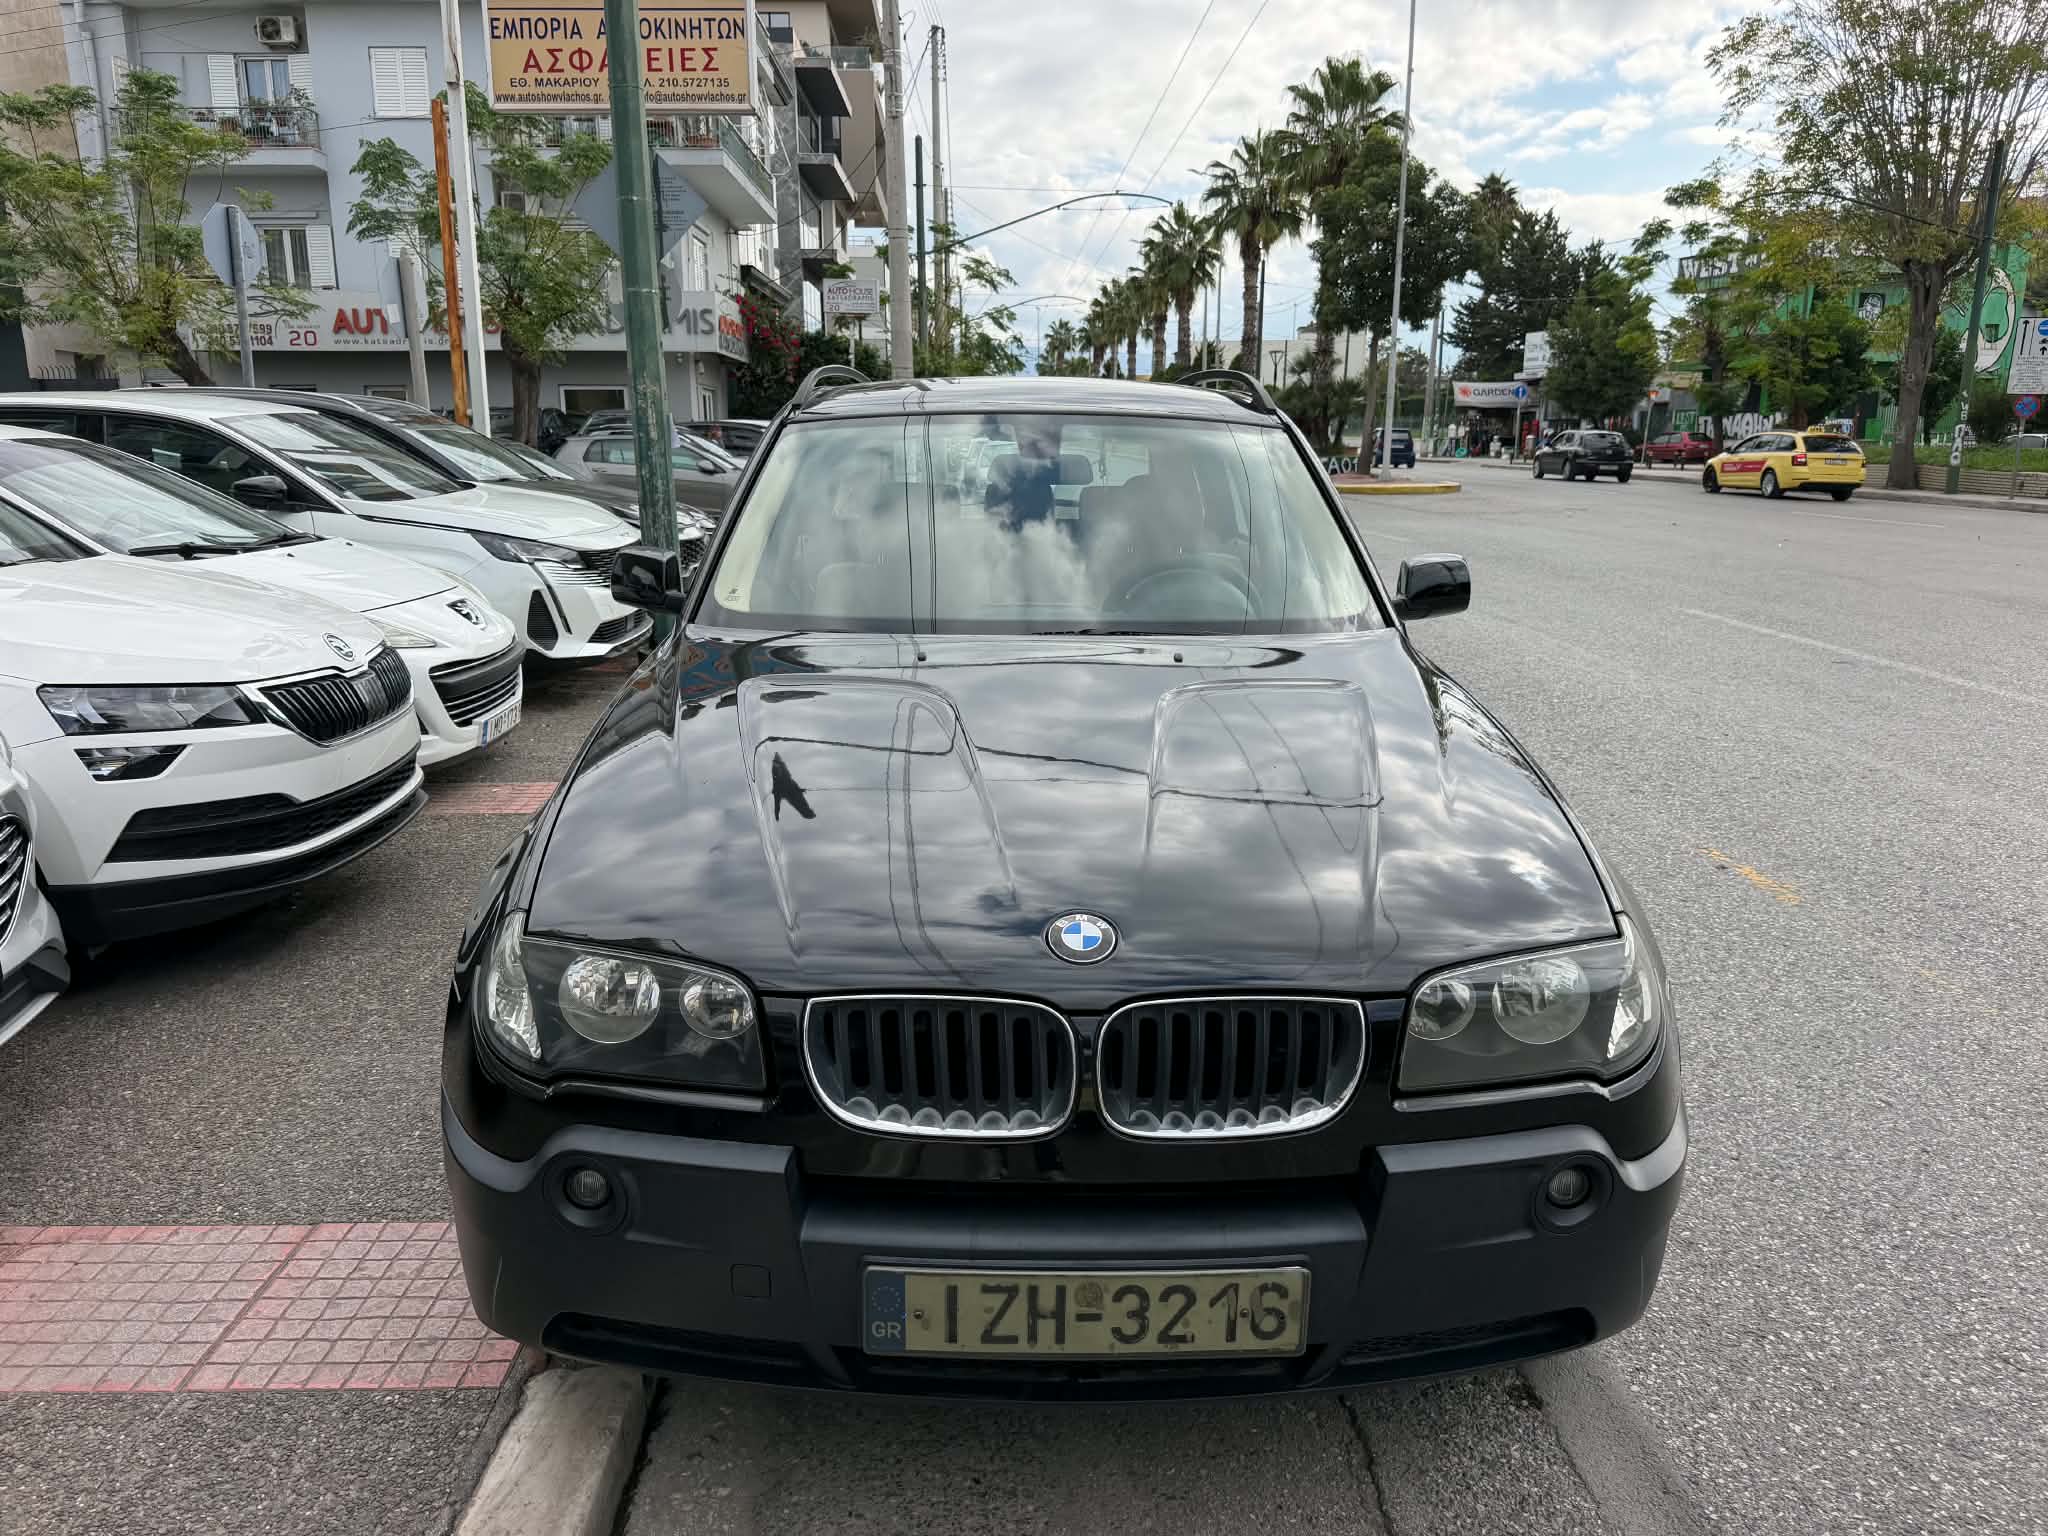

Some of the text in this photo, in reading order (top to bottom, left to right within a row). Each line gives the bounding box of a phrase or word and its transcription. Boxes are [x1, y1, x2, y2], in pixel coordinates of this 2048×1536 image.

[490, 17, 745, 40] ΕΜΠΟΡΙΑ ΑΟΚΙΝΗΤΩΝ
[523, 47, 719, 73] ΑΣΦΕΙΕΣ
[534, 77, 600, 88] ΜΑΚΑΡΙΟΥ
[658, 78, 730, 88] 210.5727135
[288, 329, 318, 347] 20
[1472, 387, 1516, 397] GARDEN
[871, 1320, 901, 1339] GR
